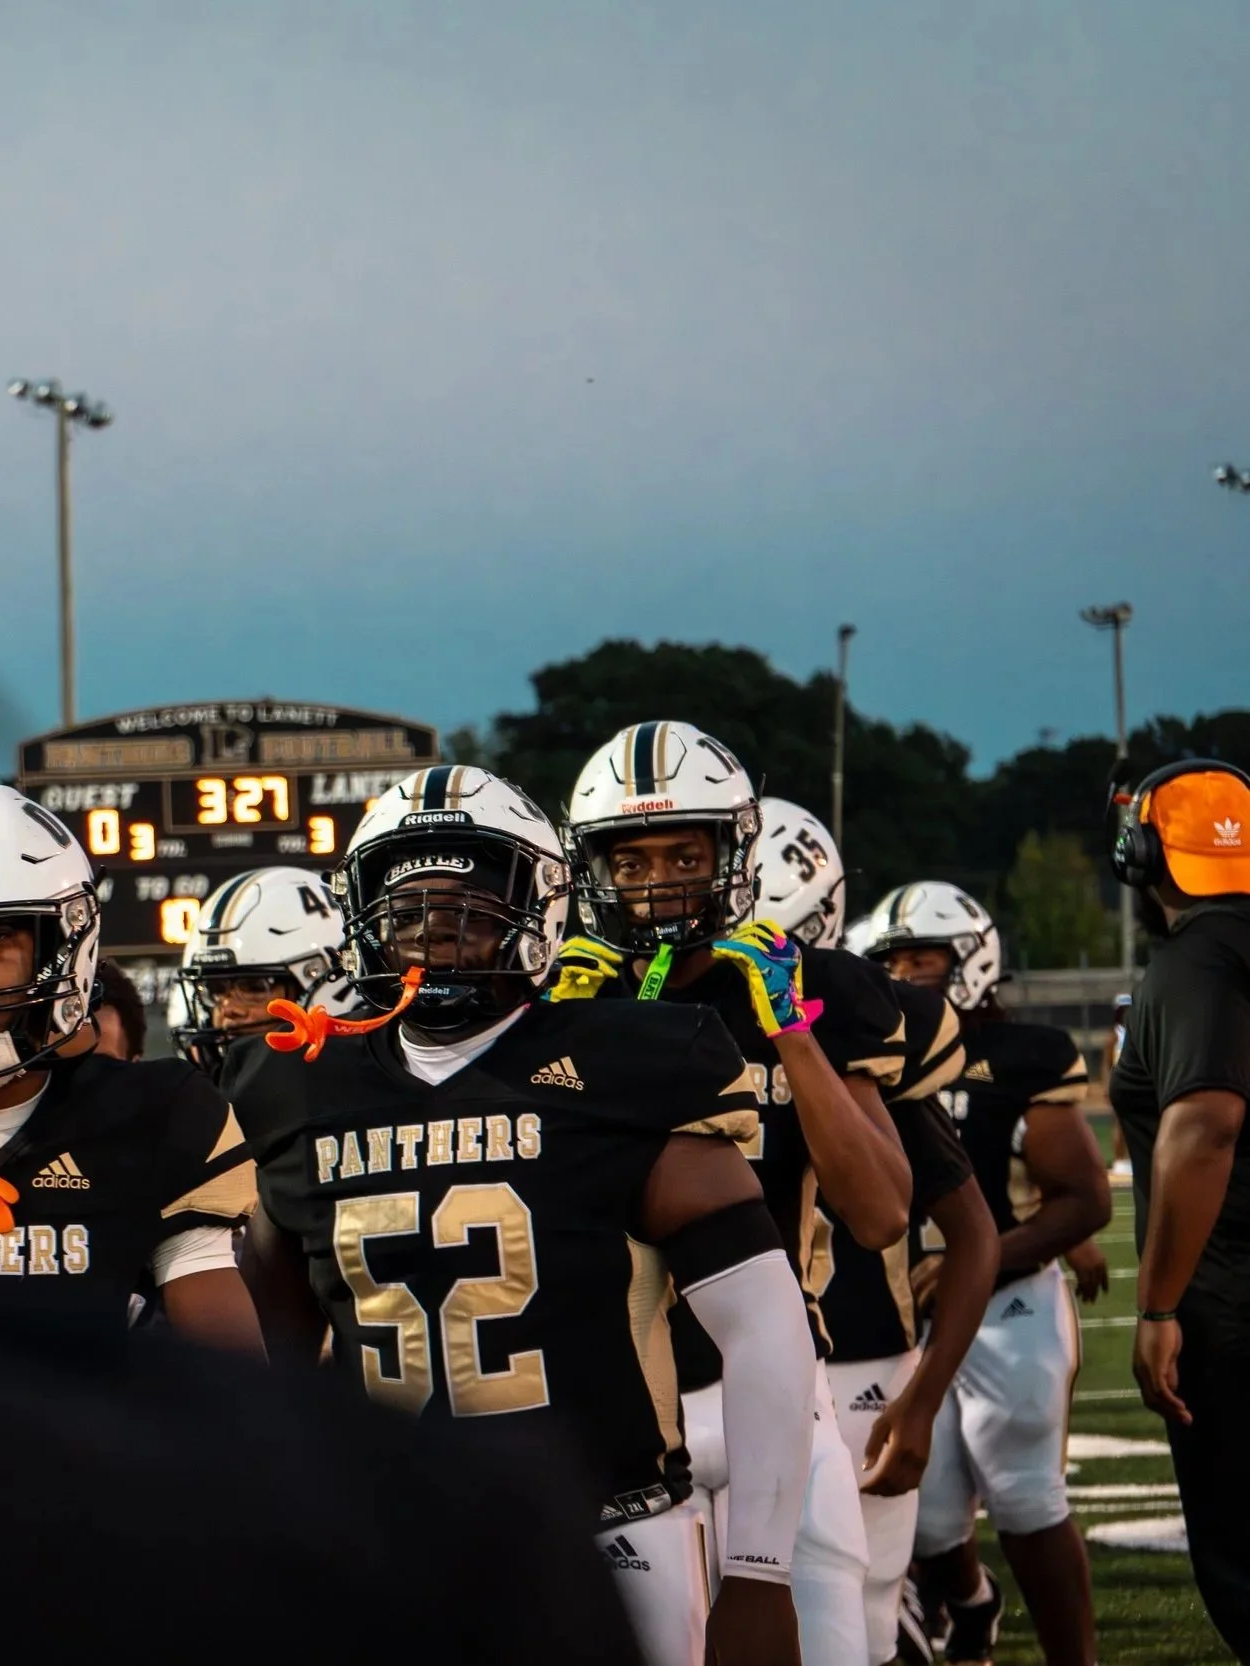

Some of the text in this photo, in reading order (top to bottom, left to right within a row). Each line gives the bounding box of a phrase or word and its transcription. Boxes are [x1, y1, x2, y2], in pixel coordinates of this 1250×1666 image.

[115, 704, 219, 735] WELCOME
[224, 703, 254, 724] TO
[404, 812, 465, 826] Riddell
[128, 822, 156, 861] 3
[308, 815, 335, 854] 3
[391, 855, 466, 881] BATTLE
[781, 828, 828, 883] 35
[418, 986, 450, 995] Riddell
[531, 1073, 584, 1091] adidas
[315, 1113, 542, 1184] PANTHERS
[32, 1175, 91, 1190] adidas
[333, 1182, 551, 1417] 52
[745, 1555, 780, 1565] BALL
